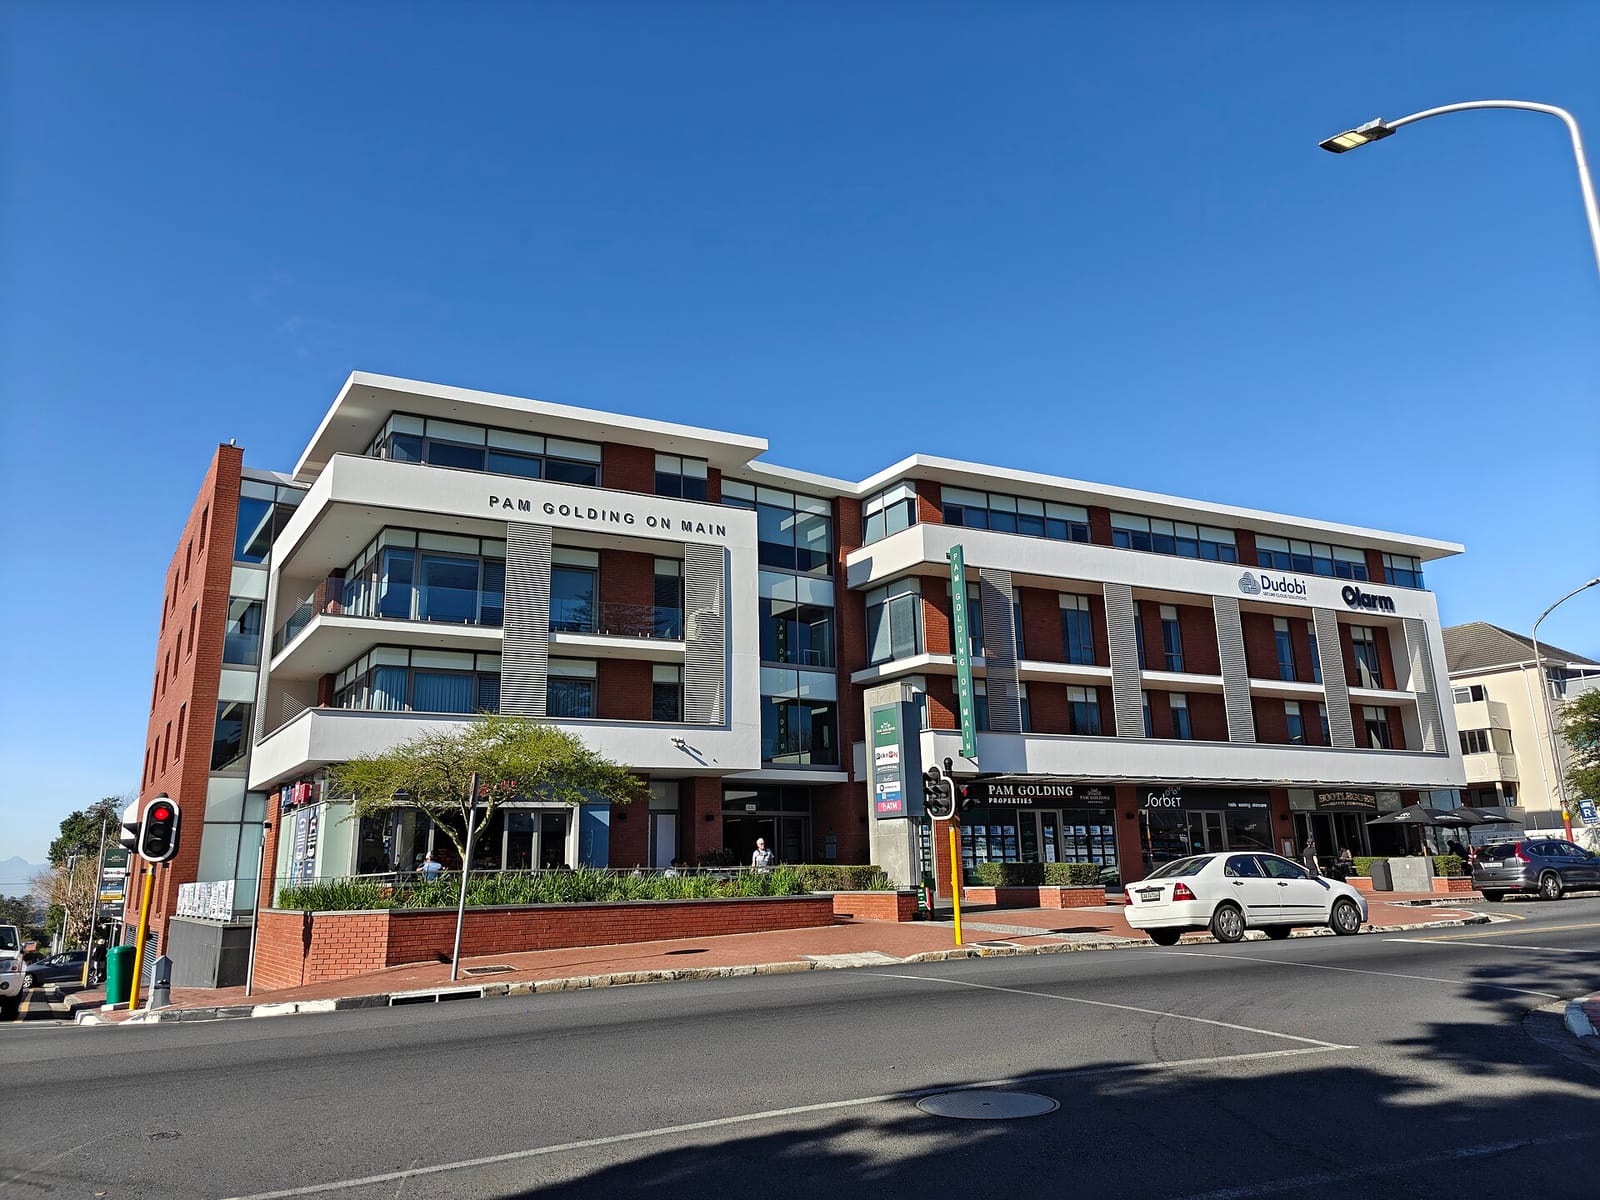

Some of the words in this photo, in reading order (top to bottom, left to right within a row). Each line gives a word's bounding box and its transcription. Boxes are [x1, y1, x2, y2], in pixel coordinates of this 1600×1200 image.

[488, 495, 531, 513] PAM
[543, 502, 635, 525] GOLDING
[646, 515, 671, 530] ON
[681, 520, 727, 537] MAIN
[1260, 574, 1307, 595] Dudobi
[1341, 584, 1396, 613] Olarm
[955, 592, 965, 667] GOLDING
[960, 678, 967, 697] ON
[963, 708, 971, 751] MAIN
[988, 785, 1014, 795] PAM
[1018, 785, 1073, 796] GOLDING
